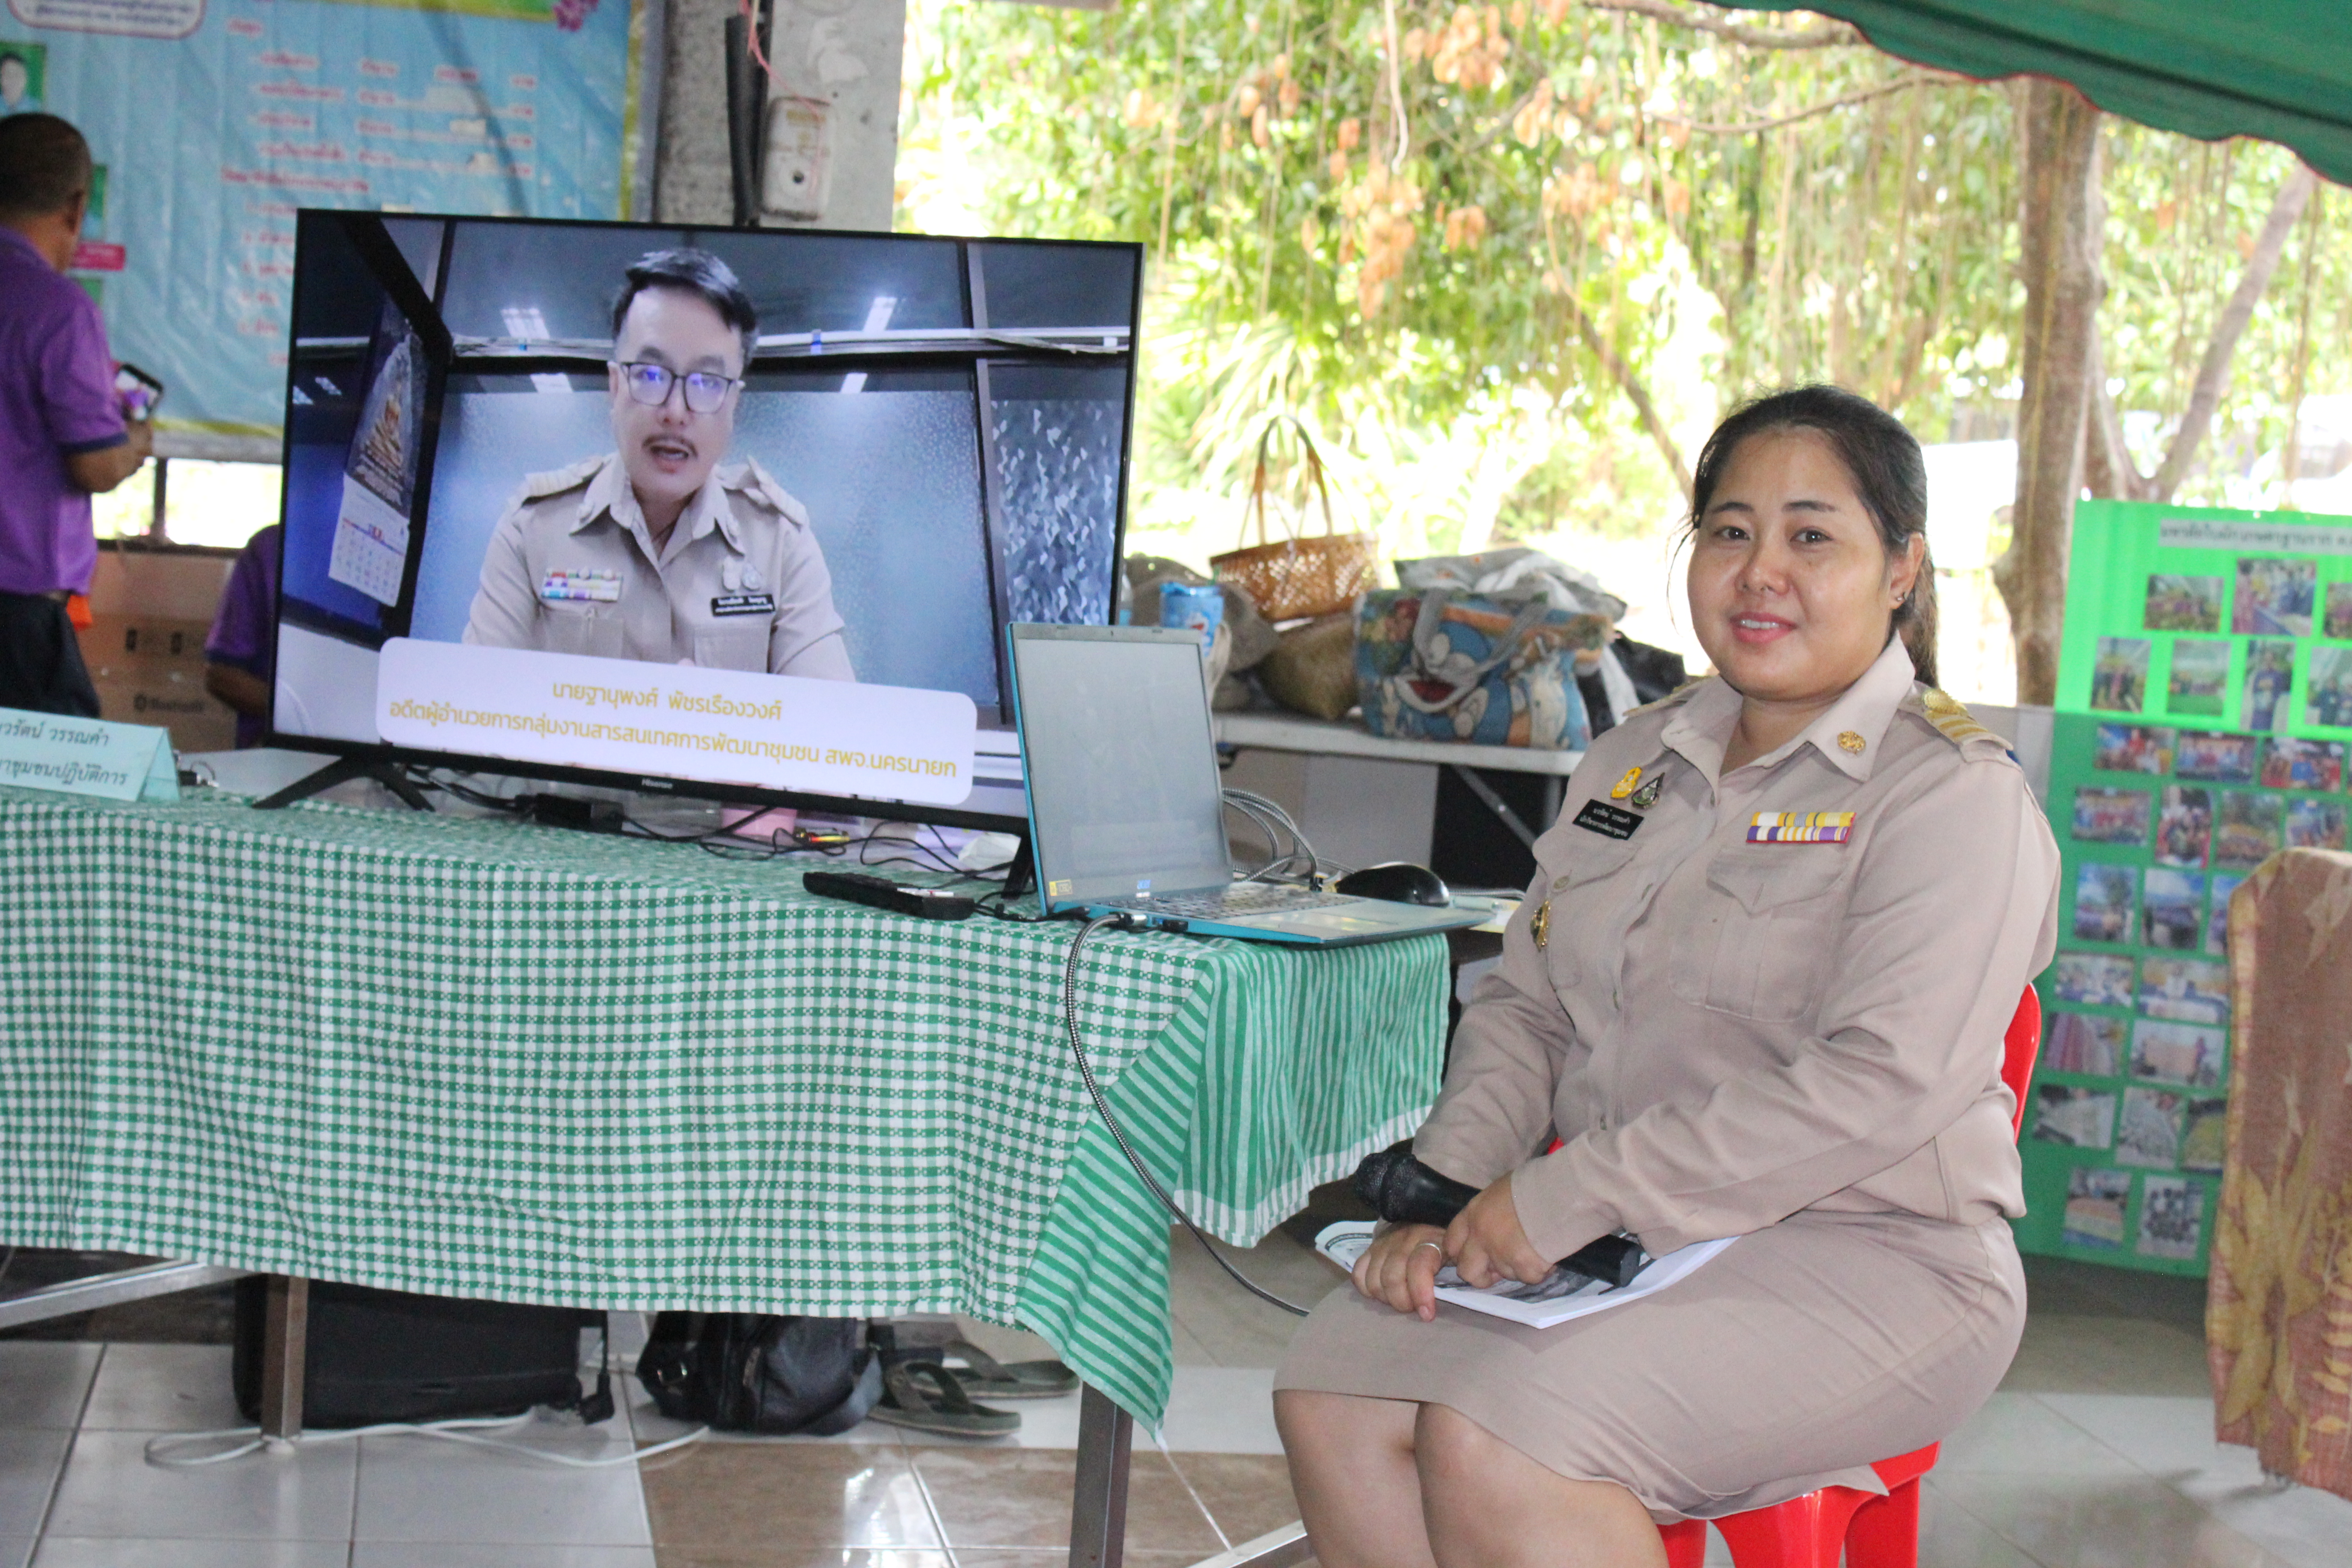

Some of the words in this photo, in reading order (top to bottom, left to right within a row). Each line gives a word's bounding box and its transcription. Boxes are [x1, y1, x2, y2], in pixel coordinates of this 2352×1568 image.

[553, 682, 658, 709] นายฐานุพงศ์
[669, 690, 783, 720] พัชรเรืองวงศ์
[390, 699, 819, 764] อดีตผู้อำนวยการกลุ่มงานสารสนเทศการพัฒนาชุมชน
[825, 749, 956, 777] สพจ.นครนายก
